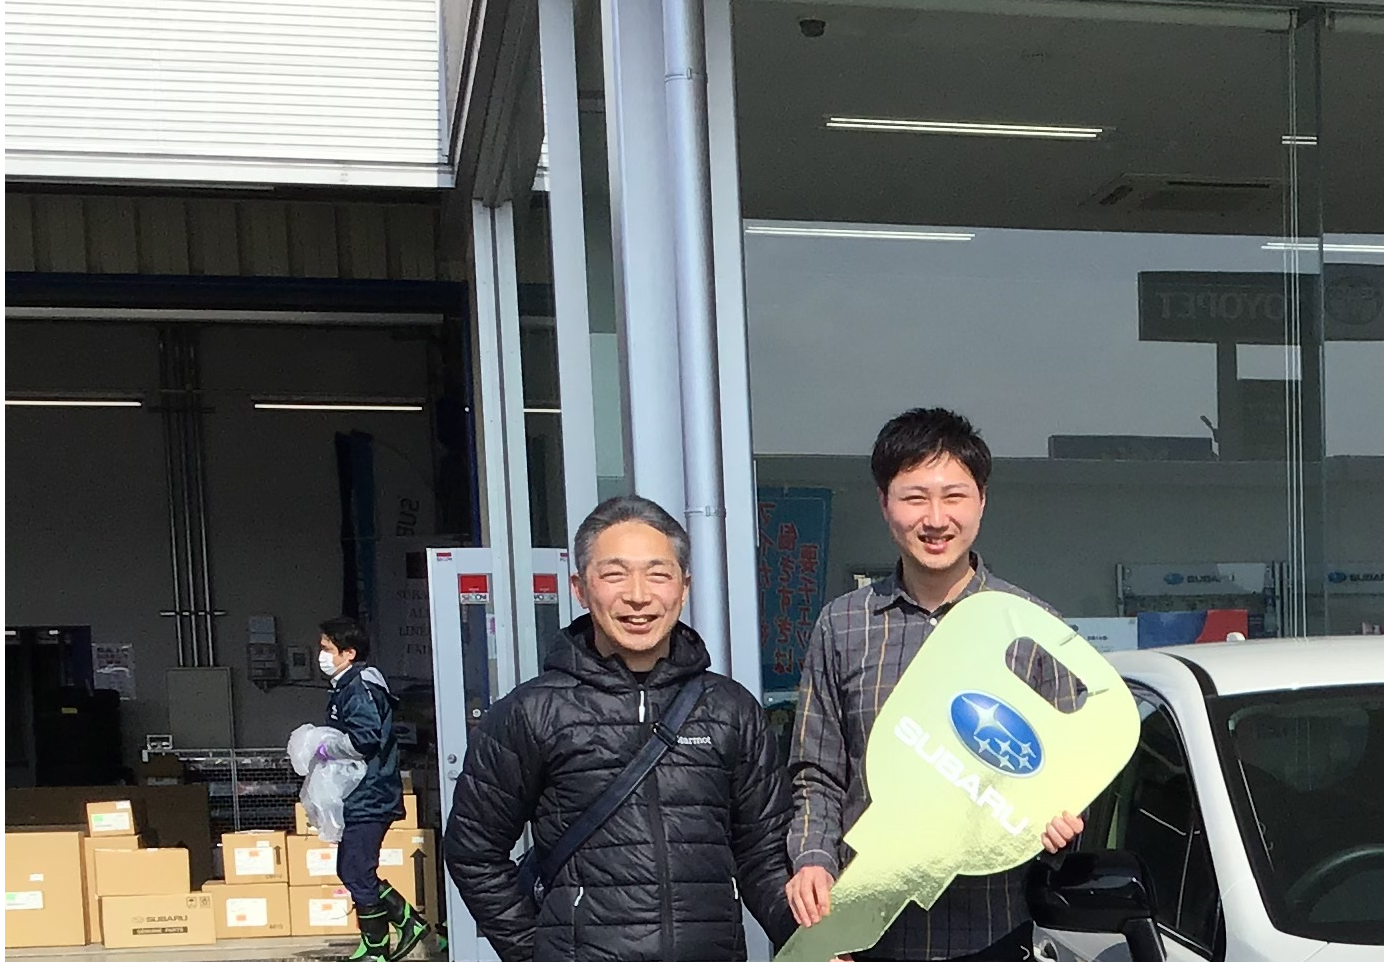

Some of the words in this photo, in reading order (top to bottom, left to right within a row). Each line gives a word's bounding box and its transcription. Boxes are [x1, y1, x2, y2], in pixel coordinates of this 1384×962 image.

[1186, 574, 1236, 584] SUBARU
[893, 715, 1031, 836] SUBARU
[145, 914, 188, 923] SUBARU
